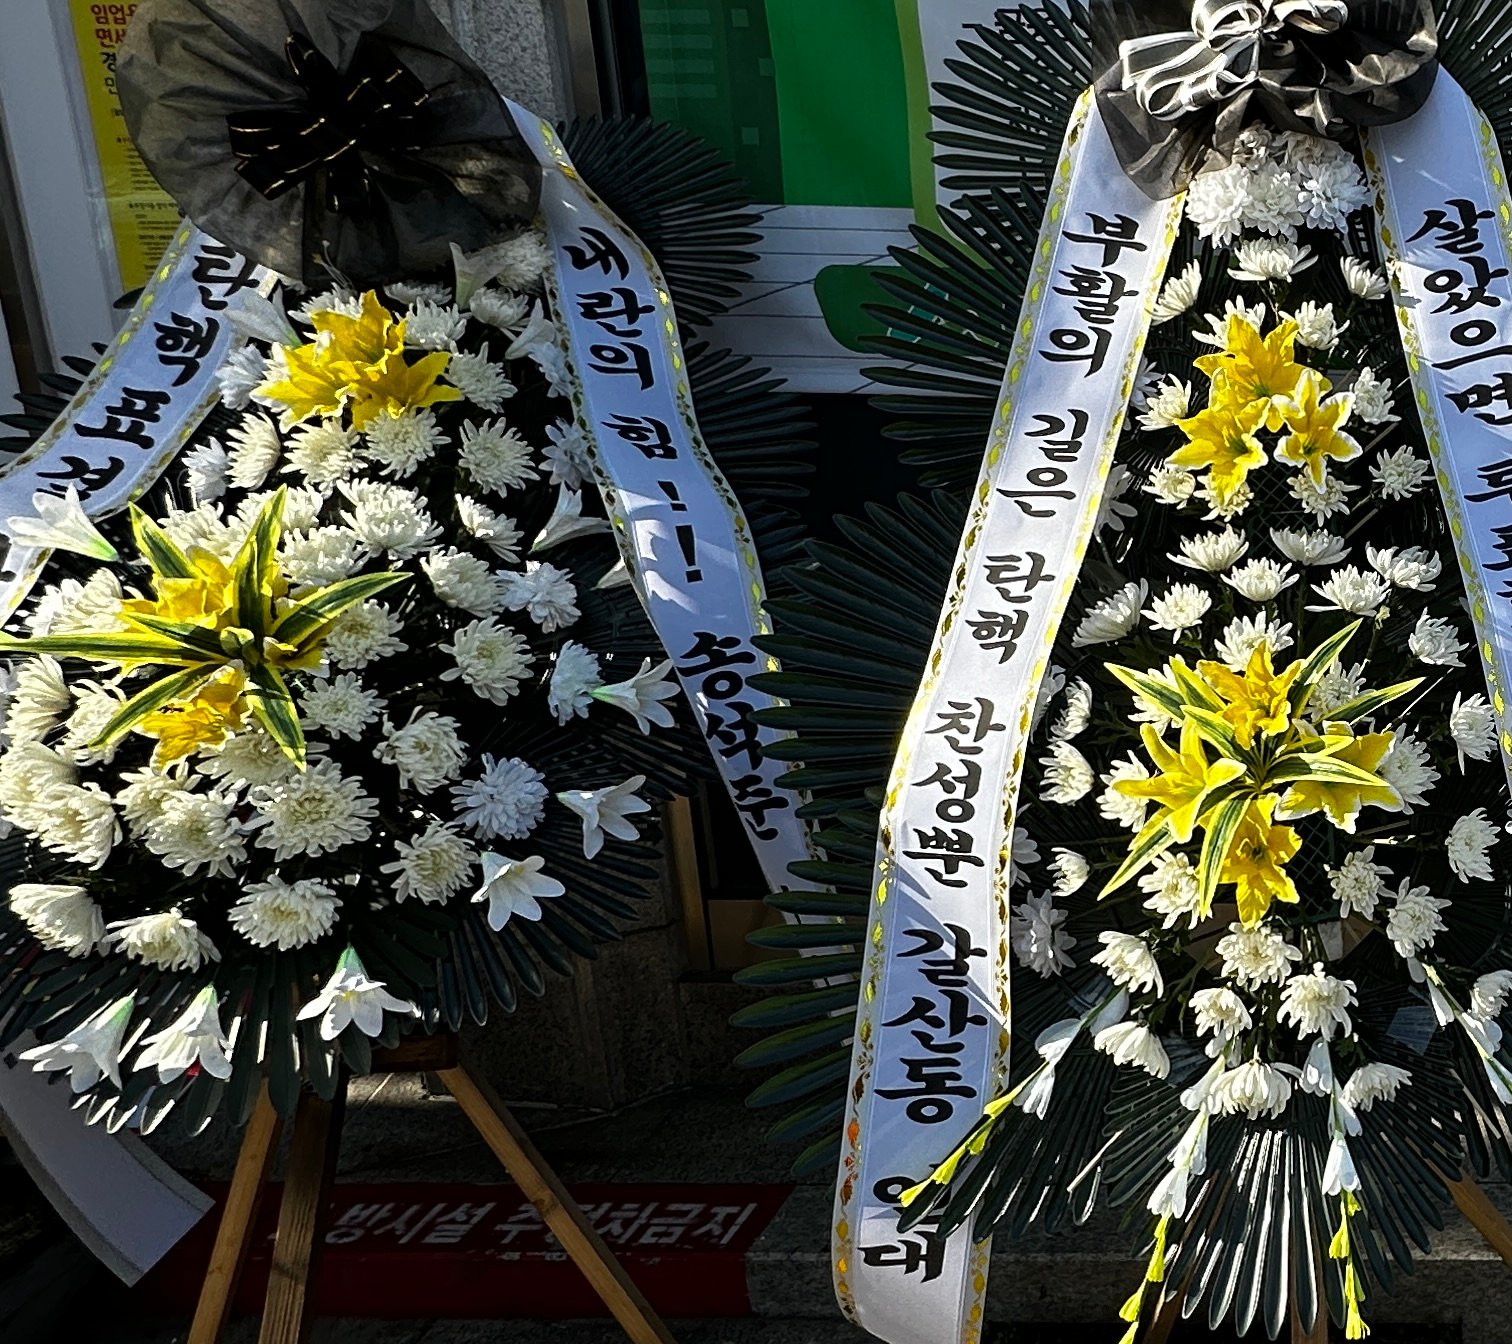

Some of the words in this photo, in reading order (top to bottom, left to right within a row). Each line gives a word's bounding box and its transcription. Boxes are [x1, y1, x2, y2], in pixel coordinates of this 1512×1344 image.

[1039, 213, 1148, 378] 부활의
[562, 226, 655, 391] 내란의
[677, 631, 790, 841] 송석준
[996, 409, 1089, 518] 길은
[965, 551, 1055, 664] 탄핵
[903, 697, 1006, 888] 찬성뿐
[874, 923, 988, 1124] 갈산동
[267, 1201, 498, 1245] 방시설
